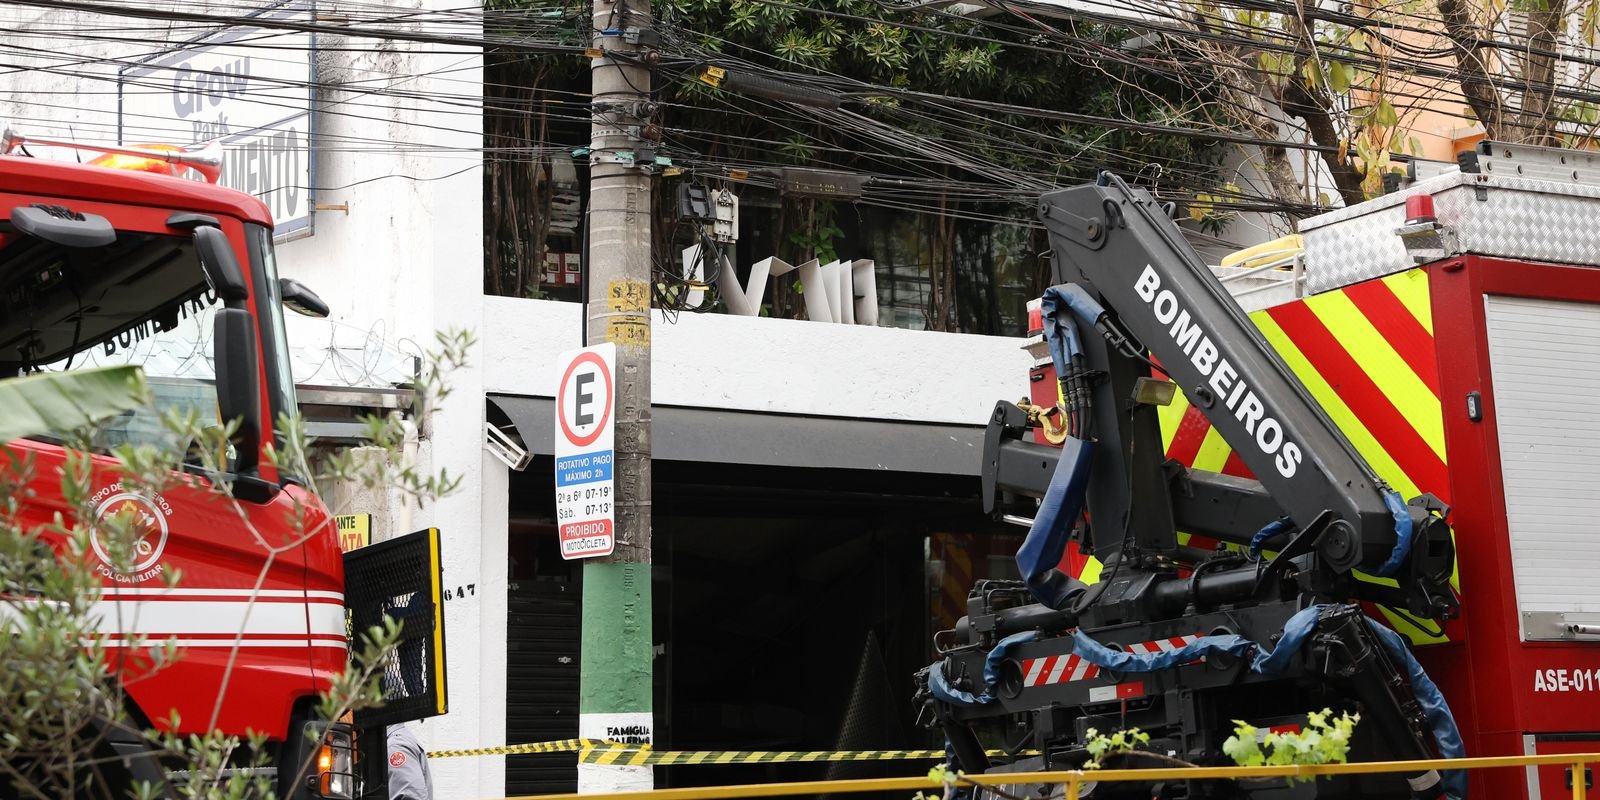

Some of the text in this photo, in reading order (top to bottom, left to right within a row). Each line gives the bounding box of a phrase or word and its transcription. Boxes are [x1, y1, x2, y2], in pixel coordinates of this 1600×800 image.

[173, 56, 250, 118] Grow
[192, 112, 230, 145] Park
[1134, 264, 1302, 478] BOMBEIROS
[576, 372, 595, 426] E
[558, 455, 611, 470] ROTATIVO PAGO
[565, 469, 604, 482] MÁXIMO 2h
[88, 487, 110, 508] ORPO
[567, 494, 572, 502] a
[336, 515, 356, 529] ANTE
[566, 523, 605, 537] PROIBIDO
[341, 533, 363, 551] ATA
[567, 538, 606, 550] MOTOCICLETA
[1534, 668, 1600, 692] ASE-011
[607, 726, 650, 736] FAMIGLIA
